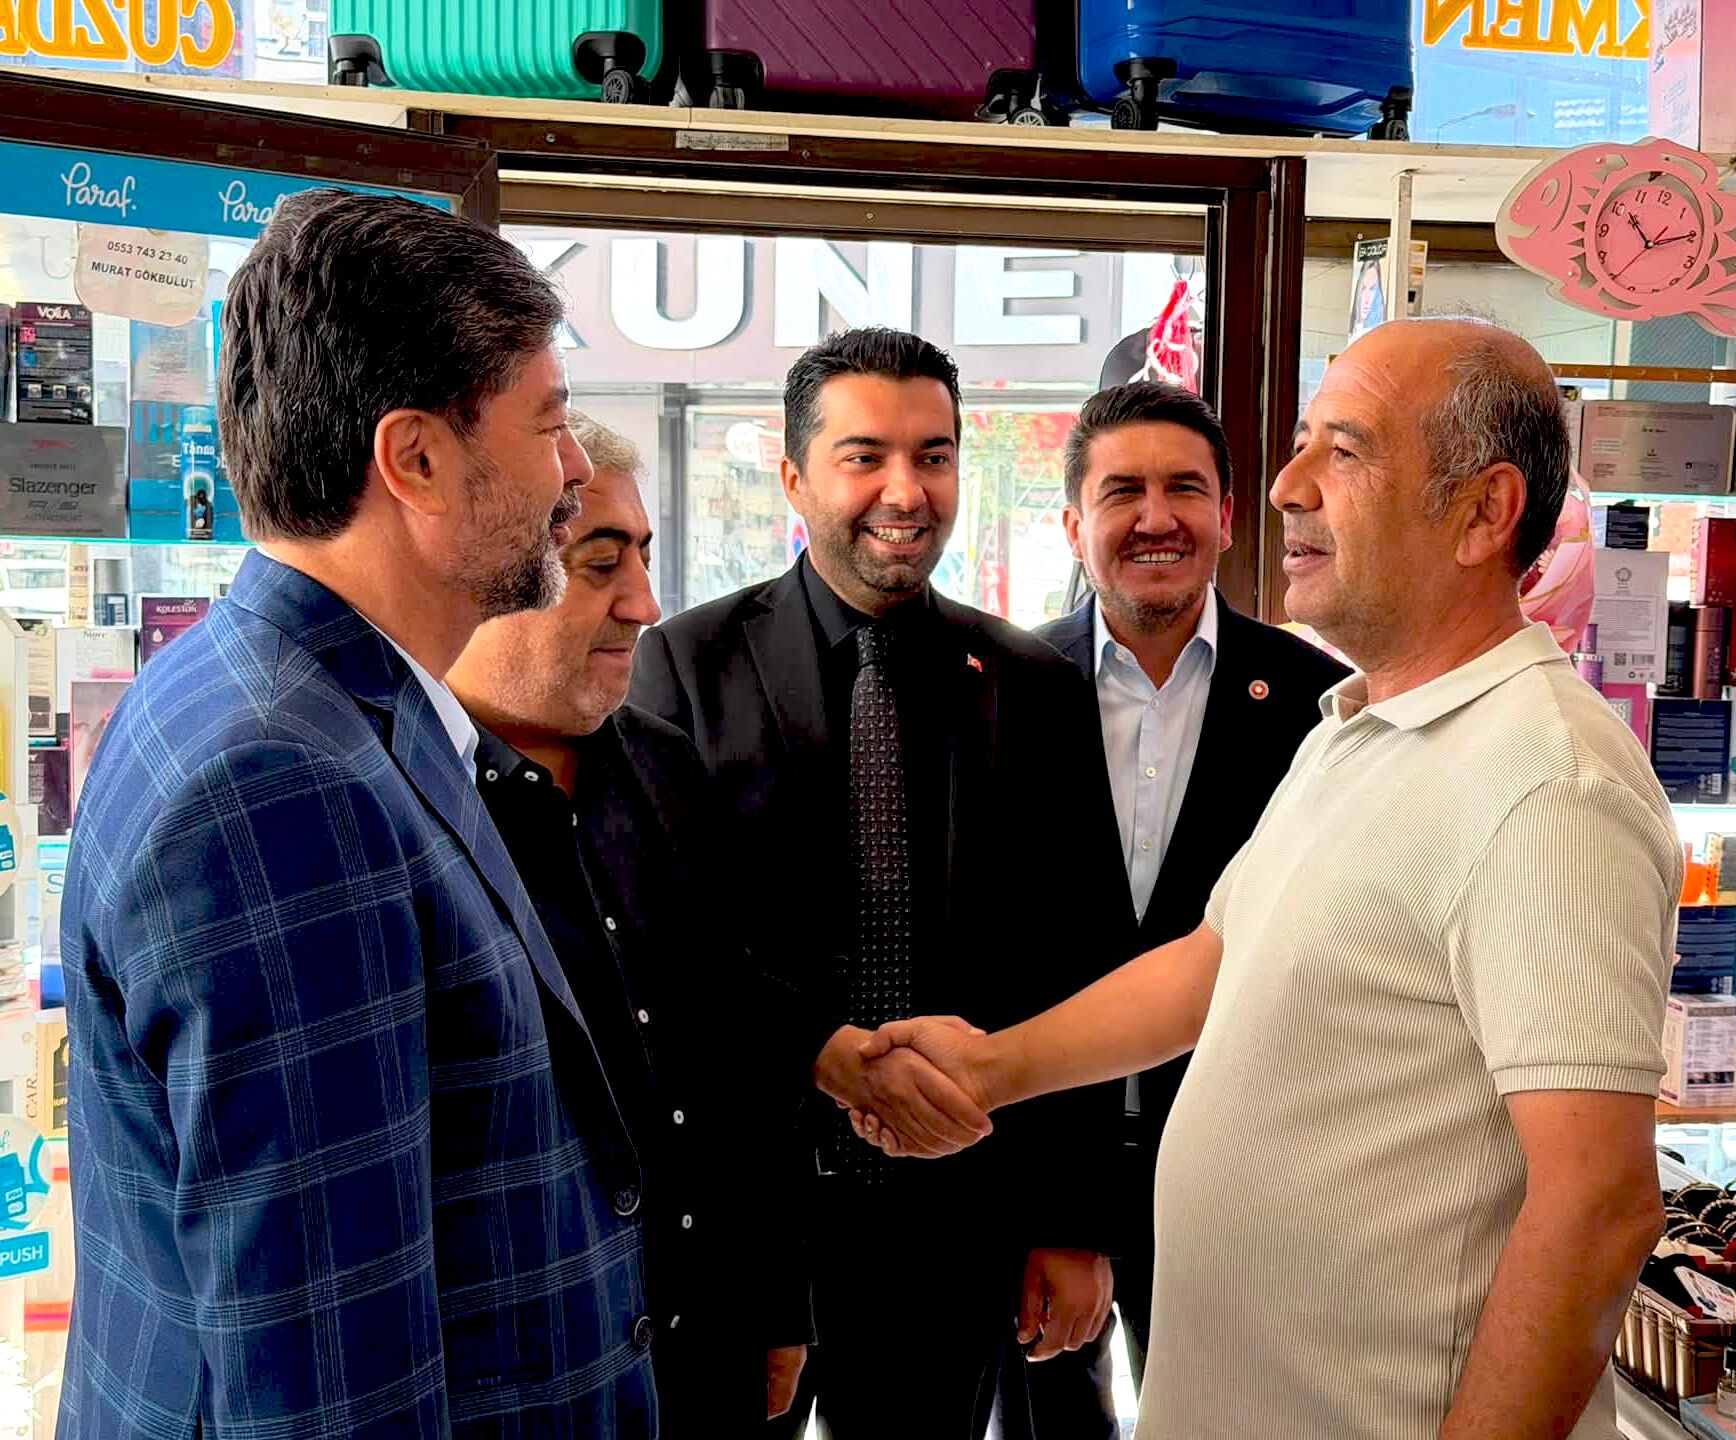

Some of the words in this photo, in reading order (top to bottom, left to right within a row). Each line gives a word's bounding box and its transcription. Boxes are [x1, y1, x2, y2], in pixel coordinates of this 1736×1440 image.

[1657, 189, 1672, 206] 12
[1611, 201, 1626, 216] 10
[1598, 223, 1610, 238] 9
[107, 240, 133, 255] 0553
[136, 245, 156, 259] 743
[174, 254, 189, 265] 40
[91, 261, 131, 277] MURAT
[8, 477, 98, 498] Slazenger
[0, 1245, 43, 1266] PUSH
